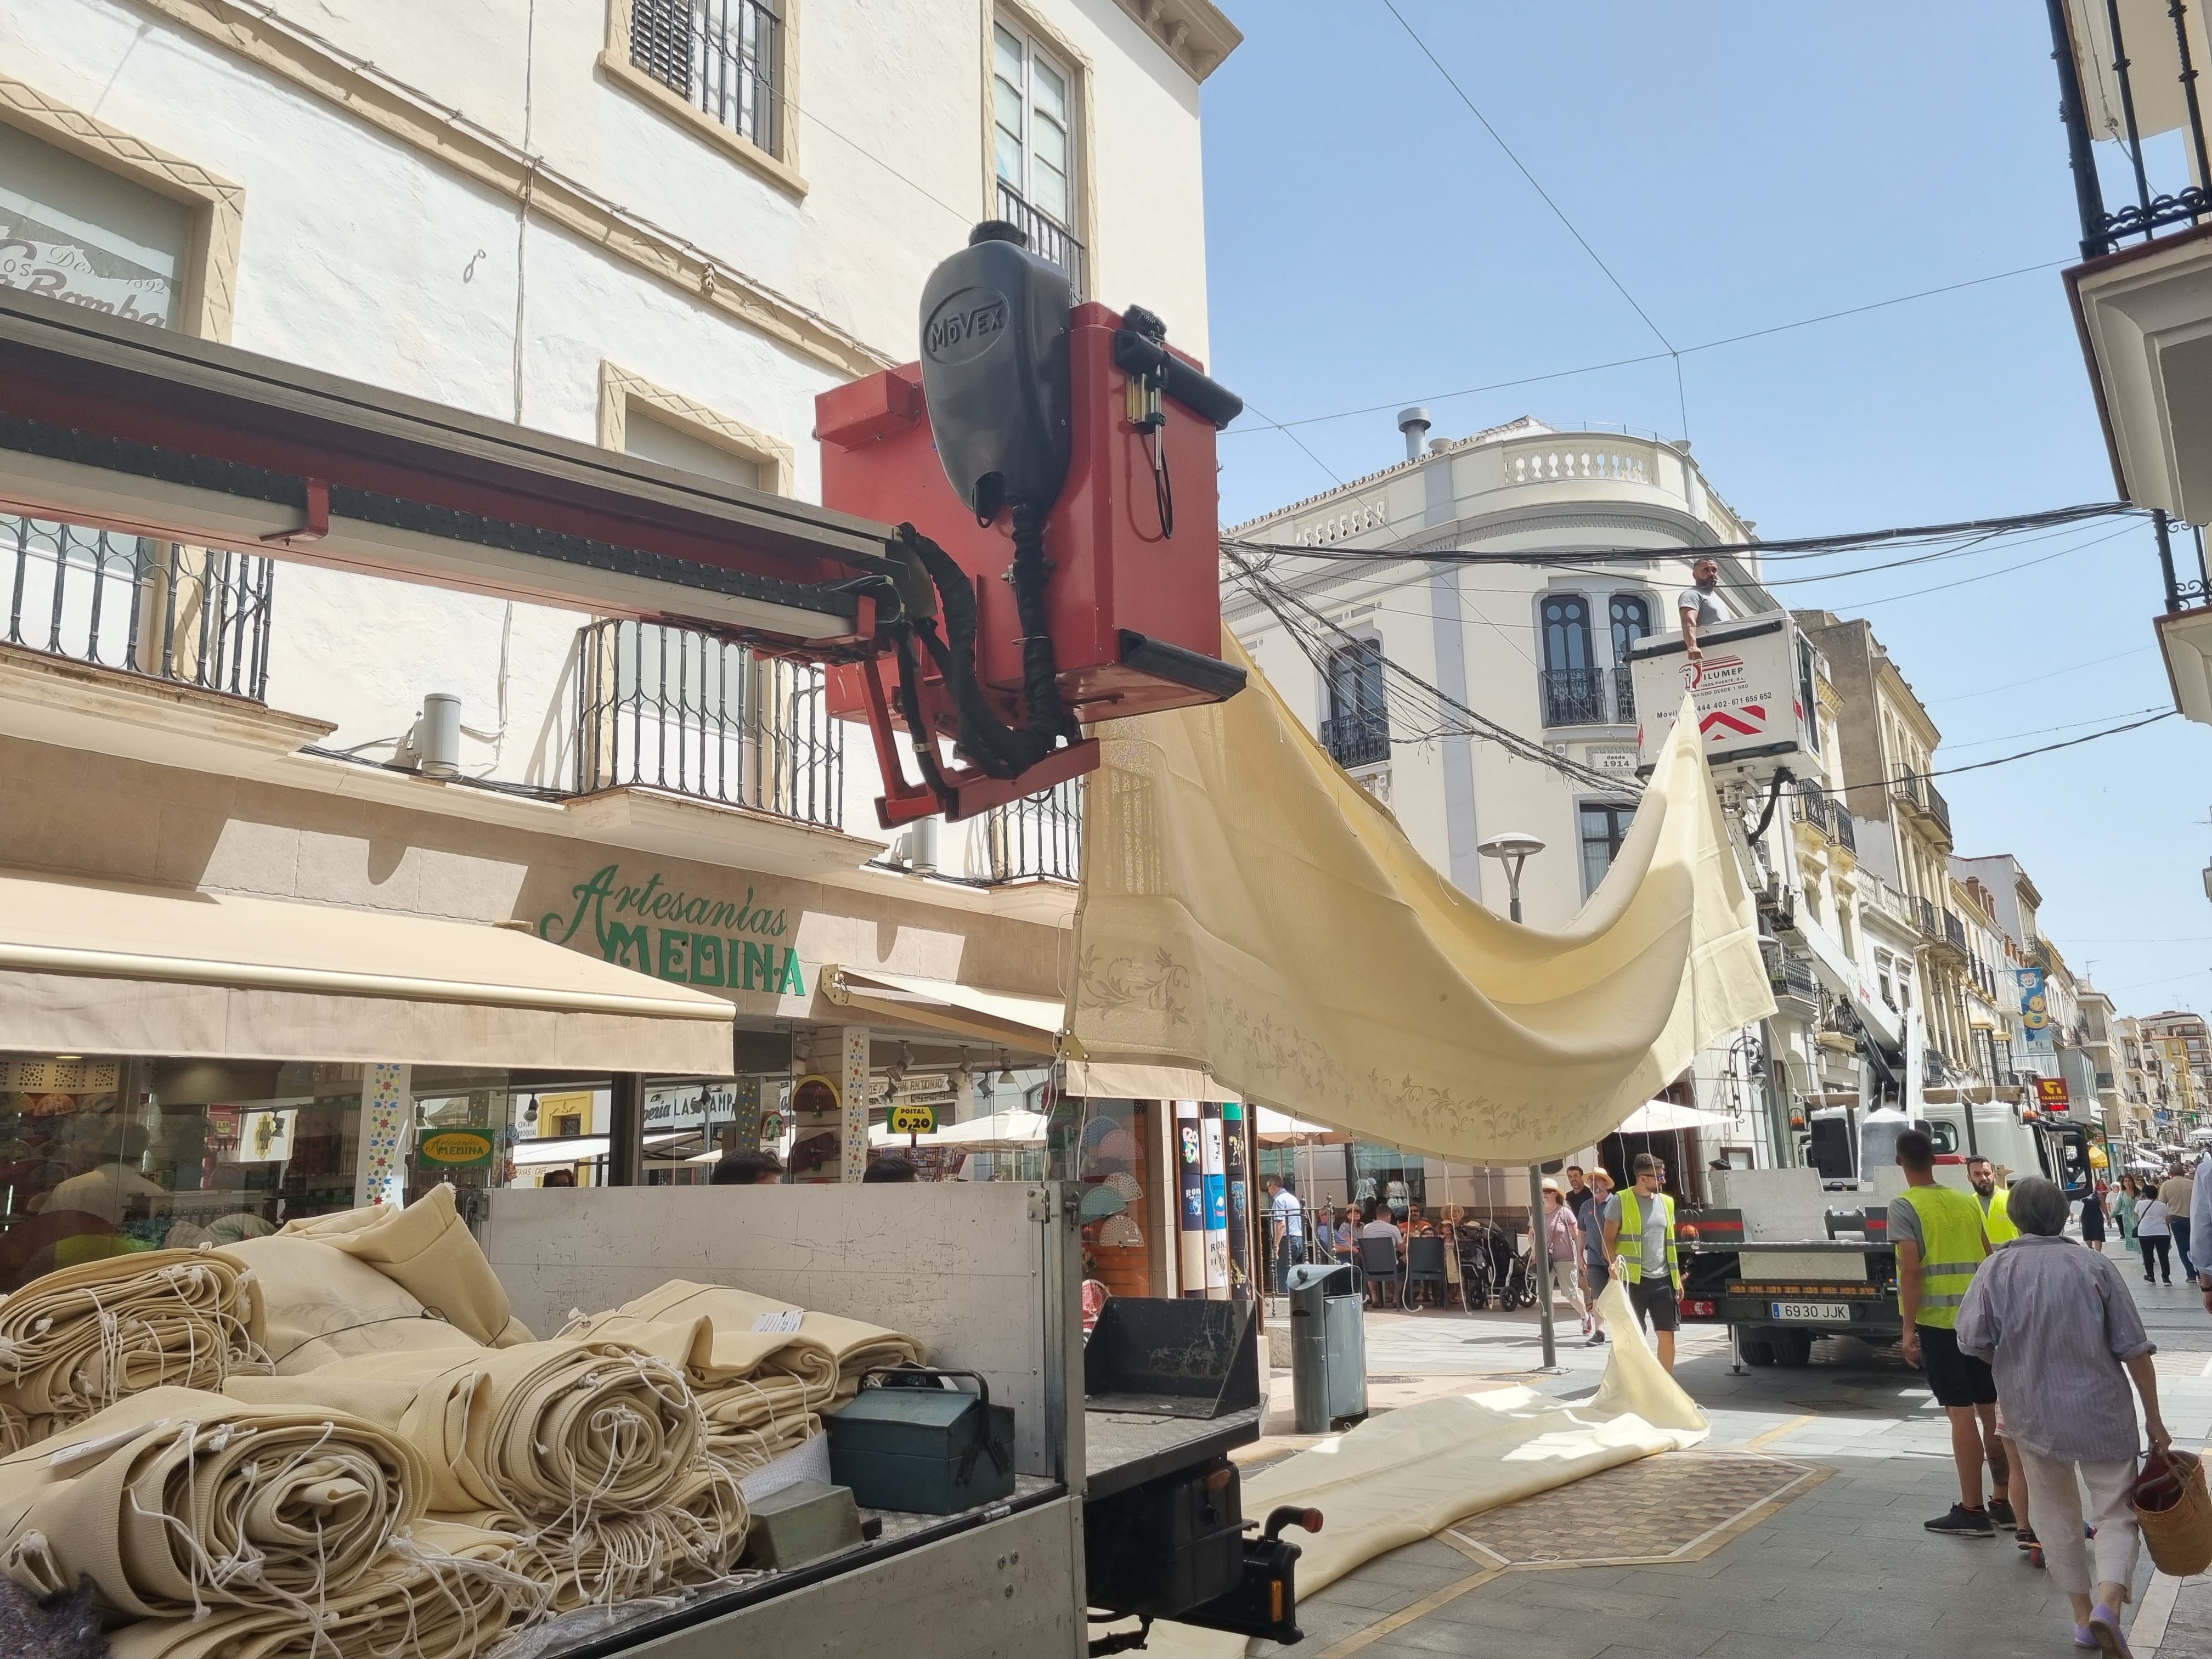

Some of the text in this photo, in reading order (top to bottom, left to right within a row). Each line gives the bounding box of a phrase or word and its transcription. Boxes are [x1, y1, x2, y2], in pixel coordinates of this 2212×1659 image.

[1703, 667, 1743, 681] ILUMEP
[1746, 695, 1758, 703] 655
[1759, 692, 1772, 700] 652
[603, 921, 806, 996] MEDINA
[704, 1093, 733, 1113] AMP
[898, 1118, 930, 1130] 0,20
[437, 1147, 484, 1155] MEDINA
[1785, 1305, 1846, 1318] 6930 JJK
